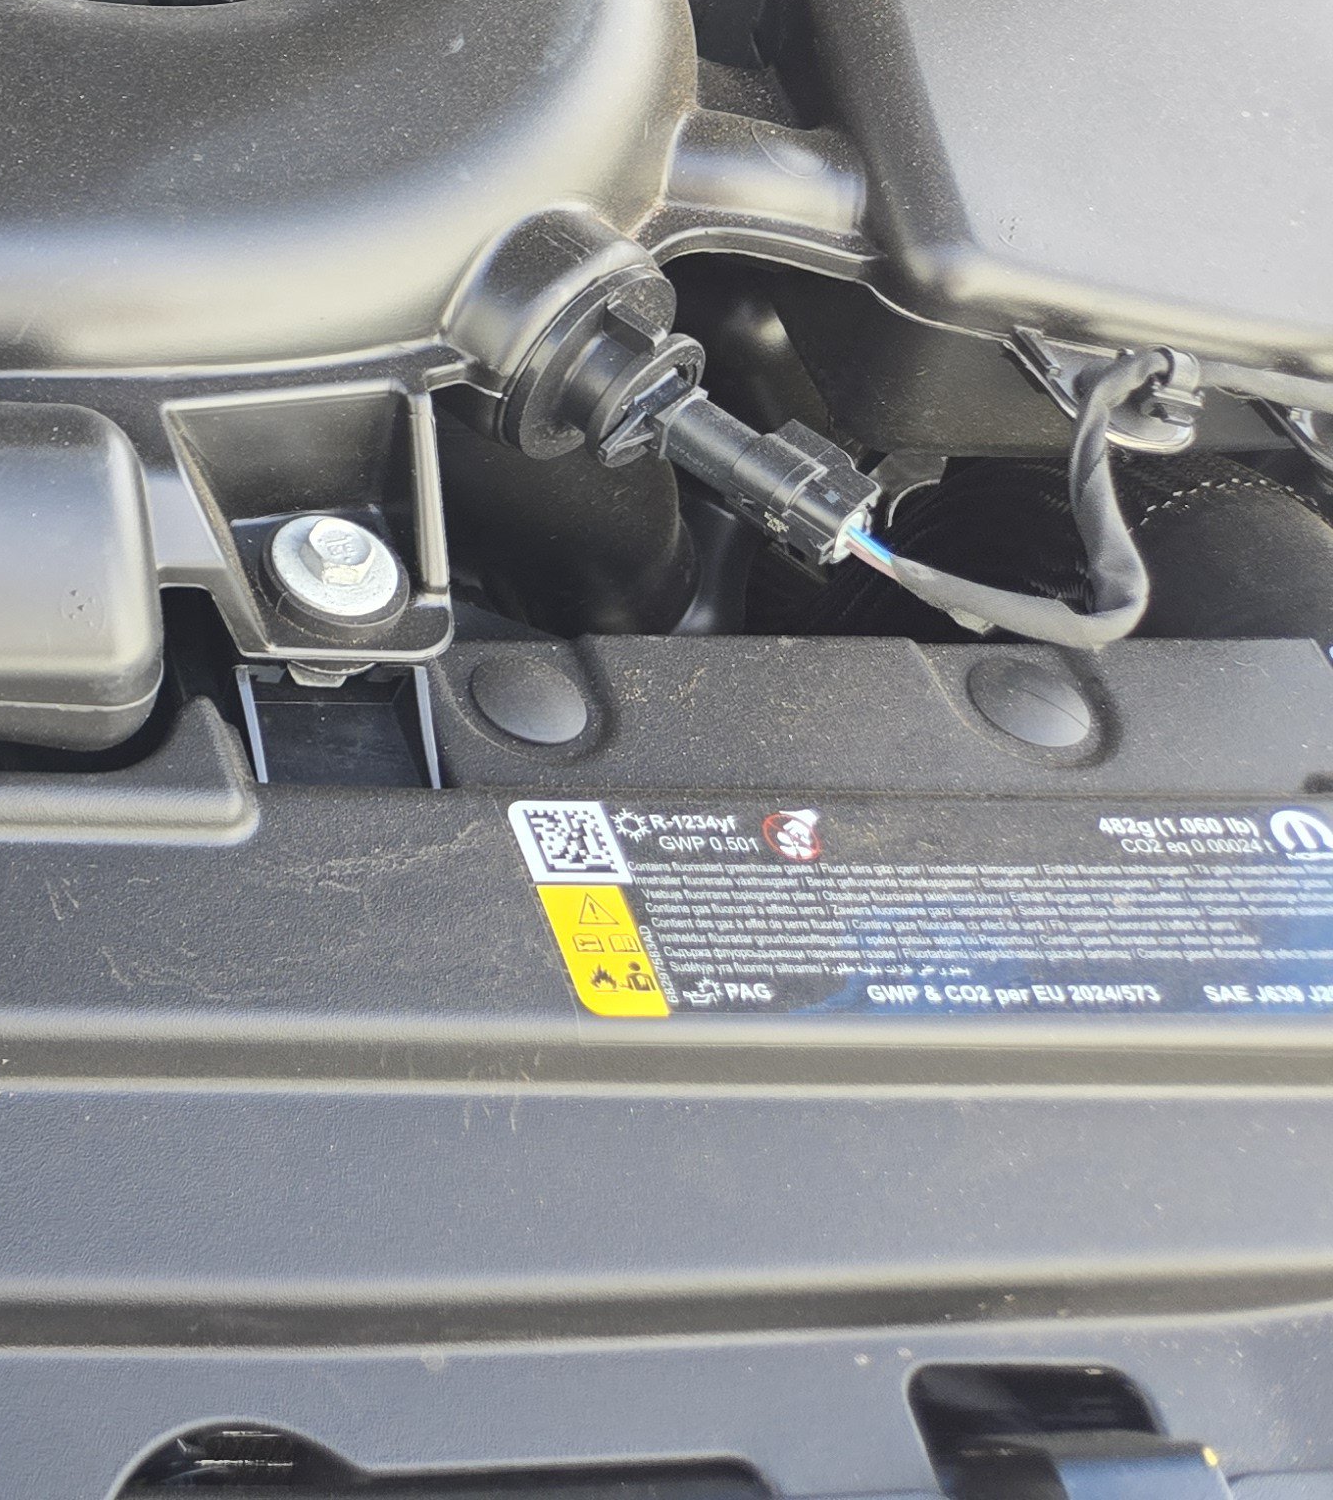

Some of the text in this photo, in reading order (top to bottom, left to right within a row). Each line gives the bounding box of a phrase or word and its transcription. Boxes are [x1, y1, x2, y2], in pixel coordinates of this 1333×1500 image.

[649, 815, 737, 834] R-1234yf
[1098, 817, 1260, 838] 482g (1.060 lb)
[658, 836, 760, 853] GWP 0.501
[1121, 839, 1164, 854] CO2
[1166, 841, 1193, 856] eq
[1191, 839, 1262, 854] 0.00024
[626, 862, 671, 872] Contains
[671, 862, 723, 872] fluorinated
[724, 862, 782, 874] greenhouse
[782, 864, 813, 874] gases
[644, 904, 690, 914] Contiene
[691, 906, 711, 916] gas
[764, 904, 798, 914] effetto
[798, 906, 824, 914] serra
[650, 918, 694, 928] Contient
[693, 918, 714, 928] des
[714, 920, 734, 931] gaz
[744, 918, 767, 928] effet
[783, 921, 810, 929] serre
[723, 983, 772, 1001] PAG
[867, 984, 1160, 1006] GWP & CO2 per EU 2024/573
[1202, 985, 1333, 1003] SAE J639 J2
